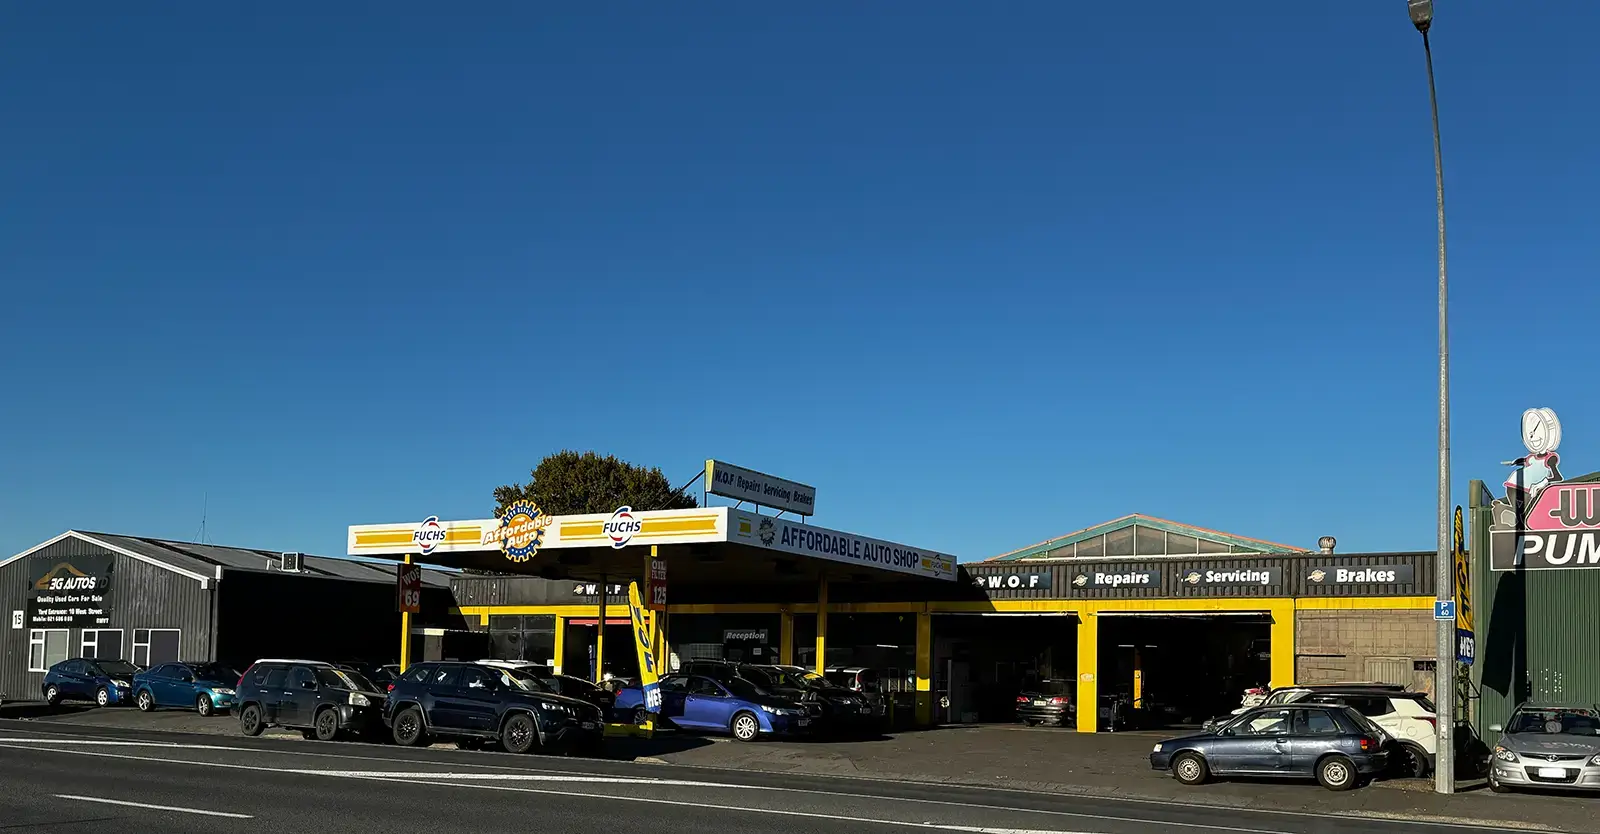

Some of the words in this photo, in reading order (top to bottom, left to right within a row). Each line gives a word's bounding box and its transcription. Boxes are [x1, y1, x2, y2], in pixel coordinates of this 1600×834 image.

[737, 477, 760, 492] Repairs
[764, 483, 790, 503] Servicing
[793, 491, 812, 505] Brakes
[483, 515, 553, 545] Affordable
[603, 521, 641, 533] FUCHS
[413, 530, 445, 541] FUCHS
[506, 531, 538, 549] Auto
[781, 525, 860, 559] AFFORDABLE
[863, 542, 891, 564] AUTO
[893, 549, 919, 569] SHOP
[652, 560, 666, 570] OIL
[1095, 572, 1149, 587] Repairs
[1205, 570, 1270, 584] Servicing
[1336, 568, 1395, 583] Brakes
[49, 577, 64, 590] 3G
[63, 576, 96, 590] AUTOS
[405, 590, 419, 607] 69
[654, 586, 666, 604] 125
[1441, 602, 1448, 610] P
[14, 614, 22, 625] 15
[726, 632, 765, 641] Reception
